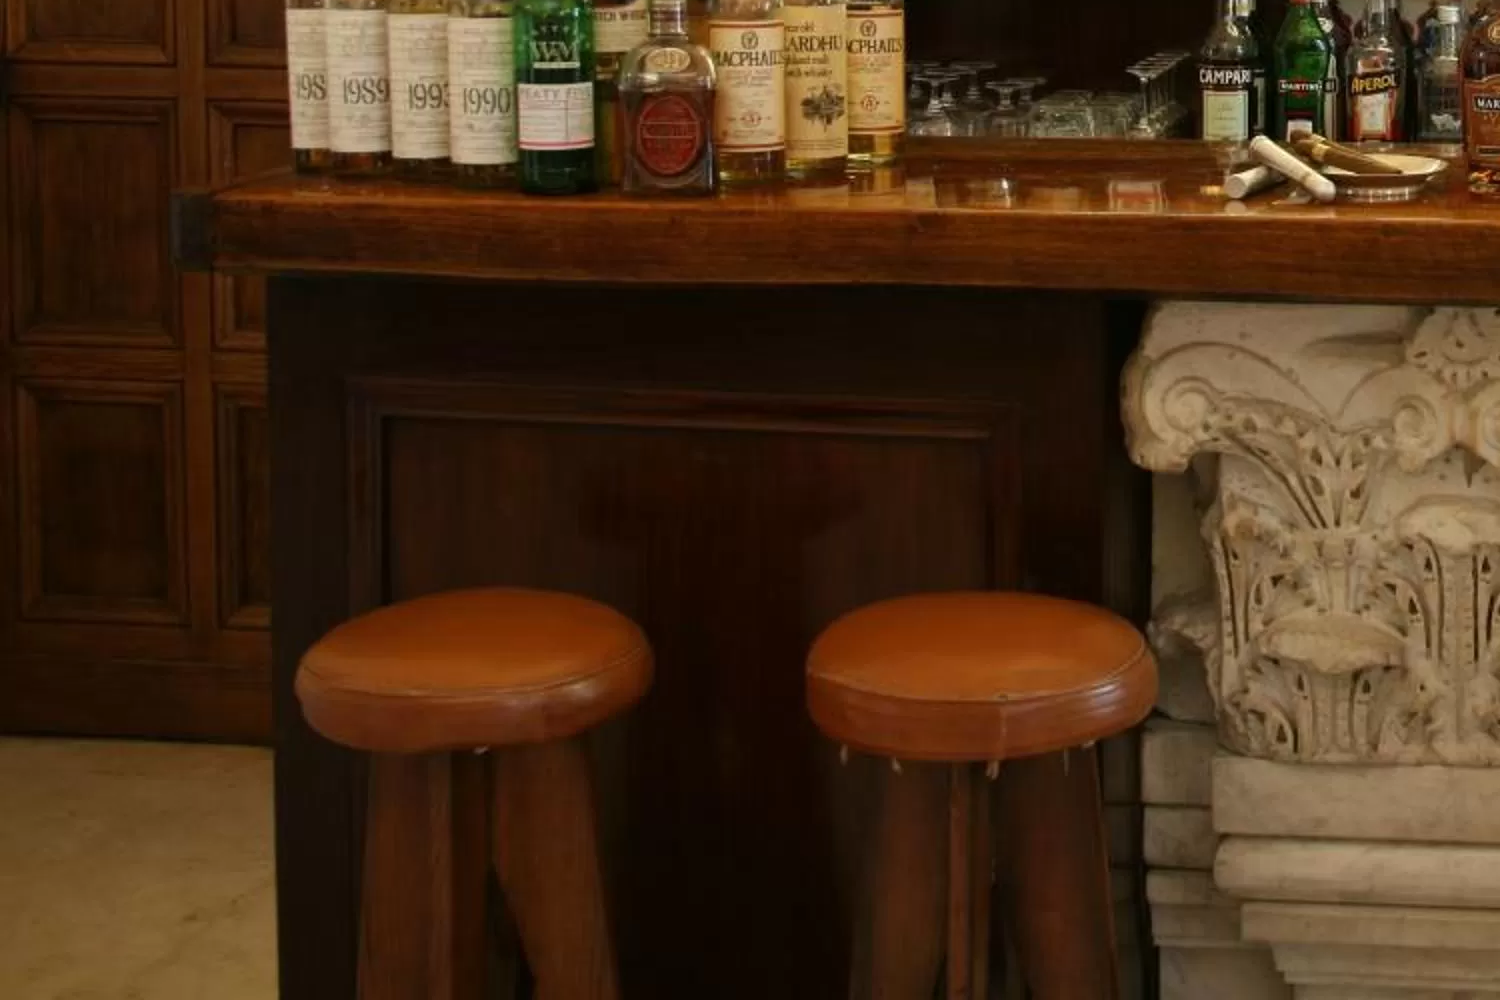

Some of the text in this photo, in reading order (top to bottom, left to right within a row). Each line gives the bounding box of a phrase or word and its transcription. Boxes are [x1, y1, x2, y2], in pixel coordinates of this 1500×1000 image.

[296, 73, 327, 101] 198
[343, 76, 390, 105] 1989
[1351, 73, 1397, 94] APEROL
[464, 87, 511, 115] 1990
